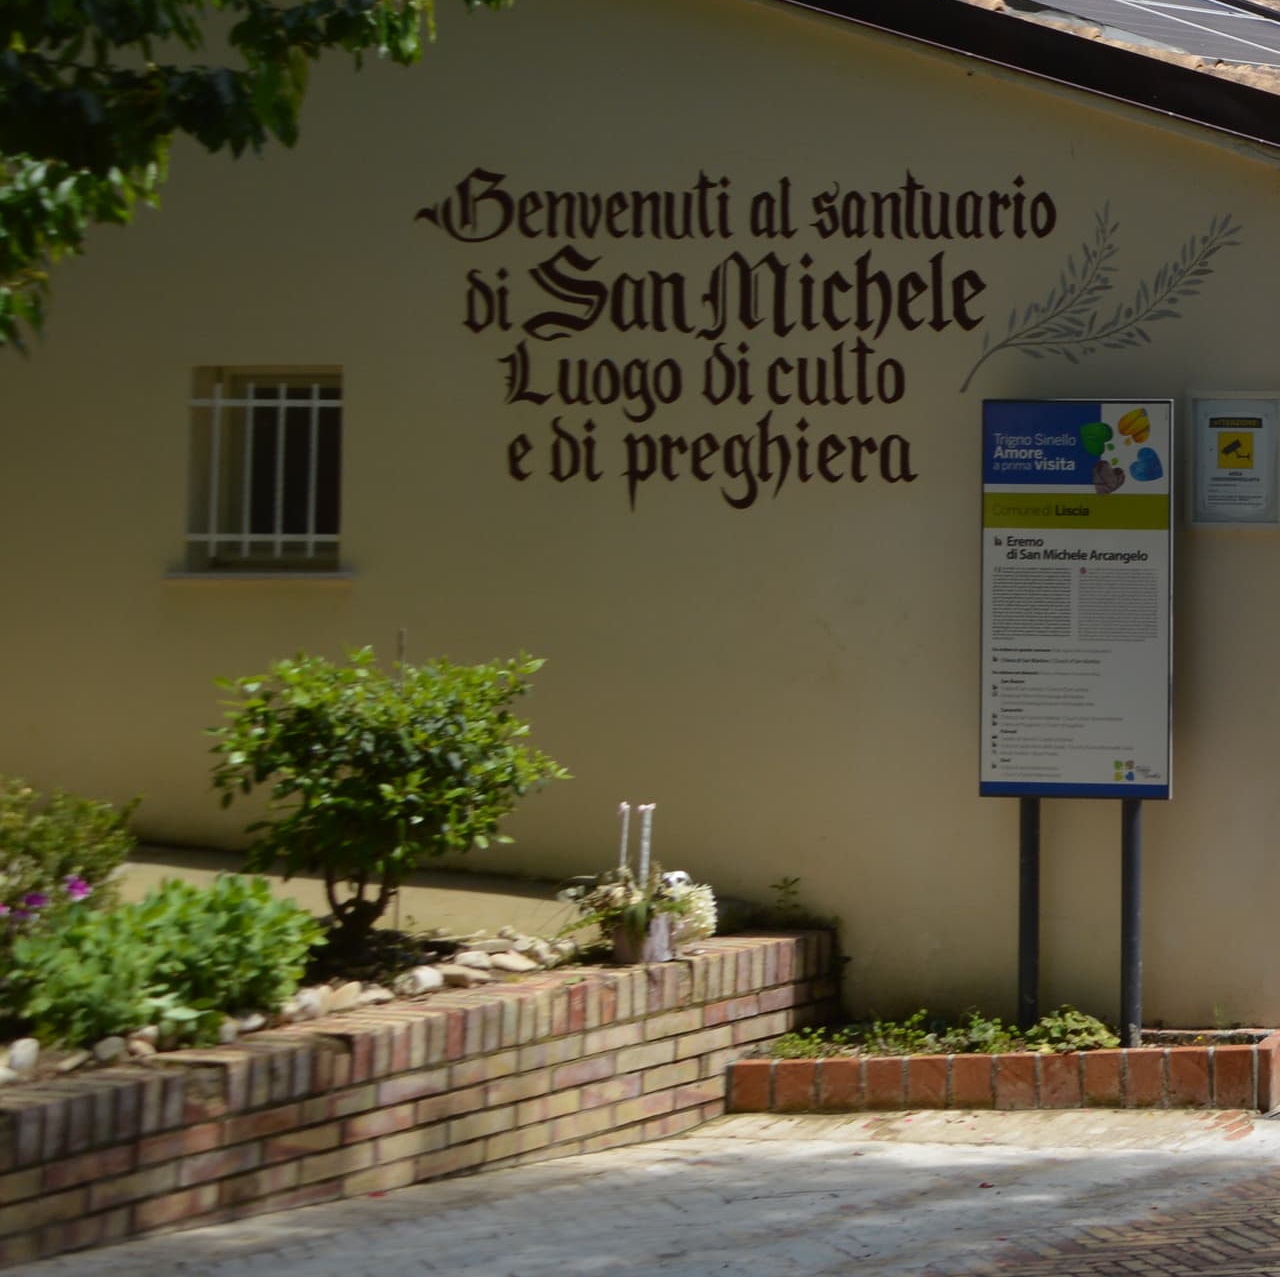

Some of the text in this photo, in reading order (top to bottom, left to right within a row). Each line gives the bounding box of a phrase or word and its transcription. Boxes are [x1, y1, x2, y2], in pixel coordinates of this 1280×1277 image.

[414, 167, 1057, 242] Benvenuti al santuario
[463, 245, 987, 340] di San Michele
[497, 337, 905, 422] Luogo di culto
[993, 433, 1077, 449] Trigno Sinello
[508, 409, 919, 512] e di preghiera
[993, 446, 1044, 459] Amore
[993, 457, 1076, 472] a prima visita
[992, 504, 1090, 517] Comune di Liscia
[1007, 535, 1044, 547] Eremo
[1006, 549, 1149, 565] di San Michele Arcangelo
